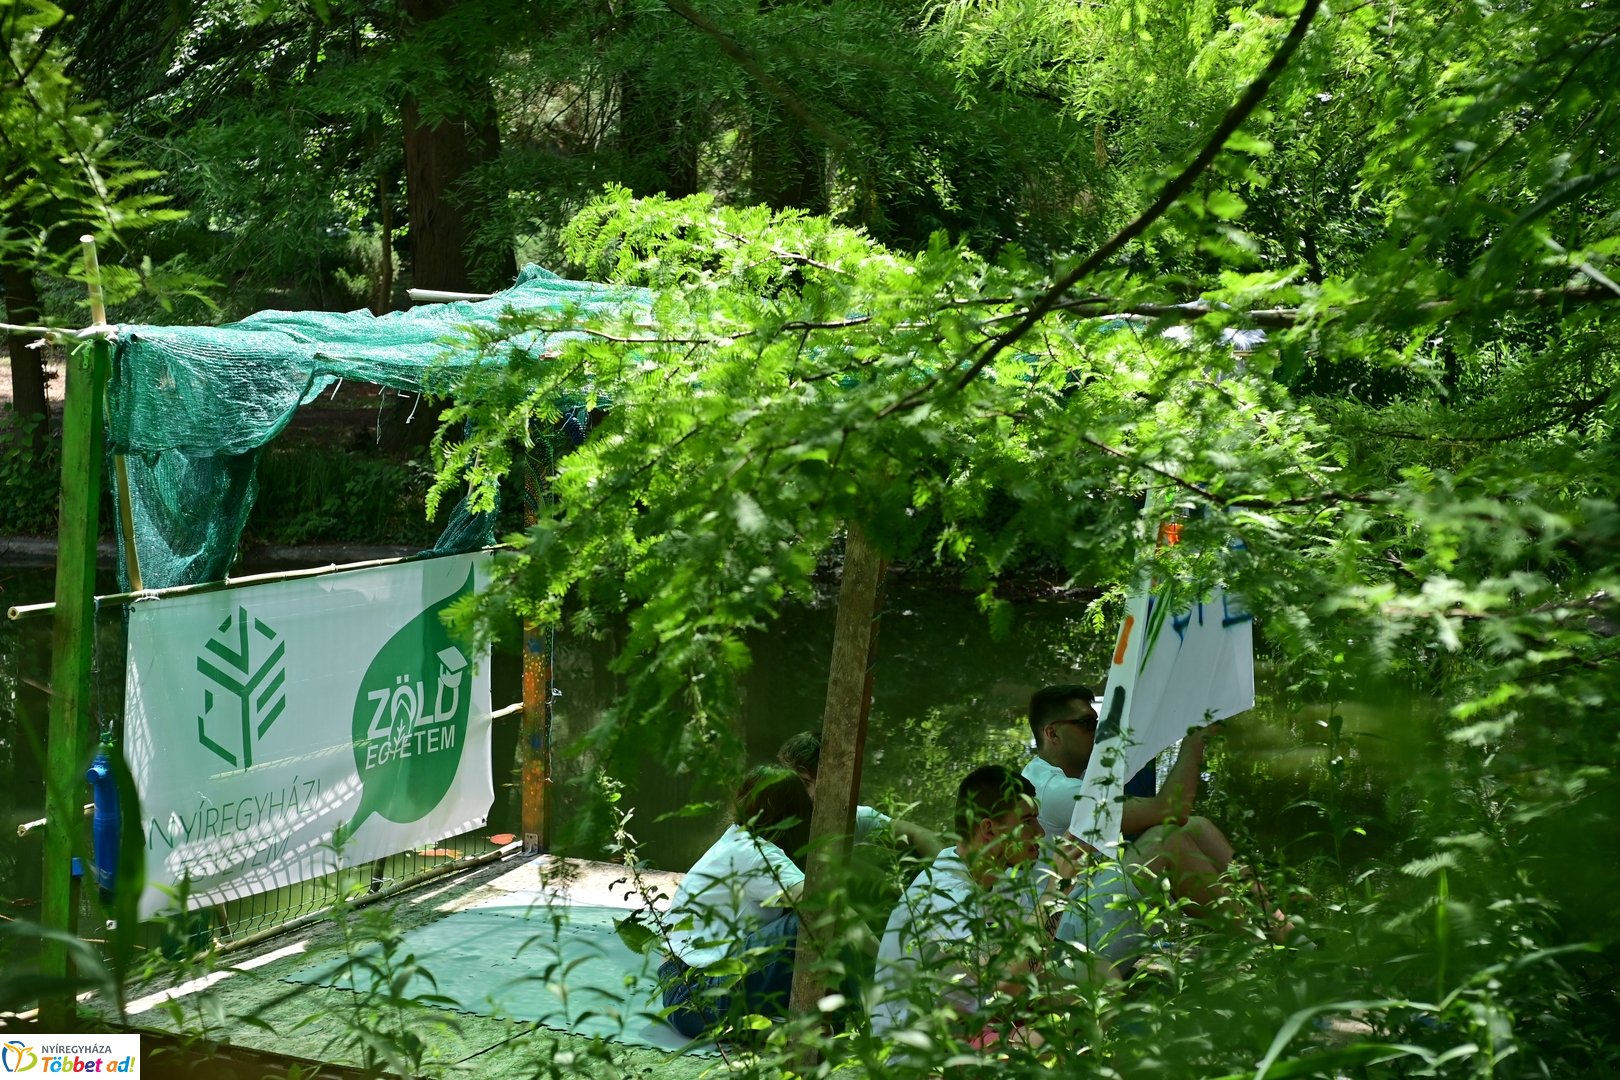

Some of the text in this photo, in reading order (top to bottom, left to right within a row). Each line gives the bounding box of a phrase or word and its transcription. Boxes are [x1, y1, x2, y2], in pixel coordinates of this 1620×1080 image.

[367, 673, 460, 740] ZÖLD
[364, 724, 456, 770] EGYETEM
[149, 775, 321, 851] NYÍREGYHÁZI
